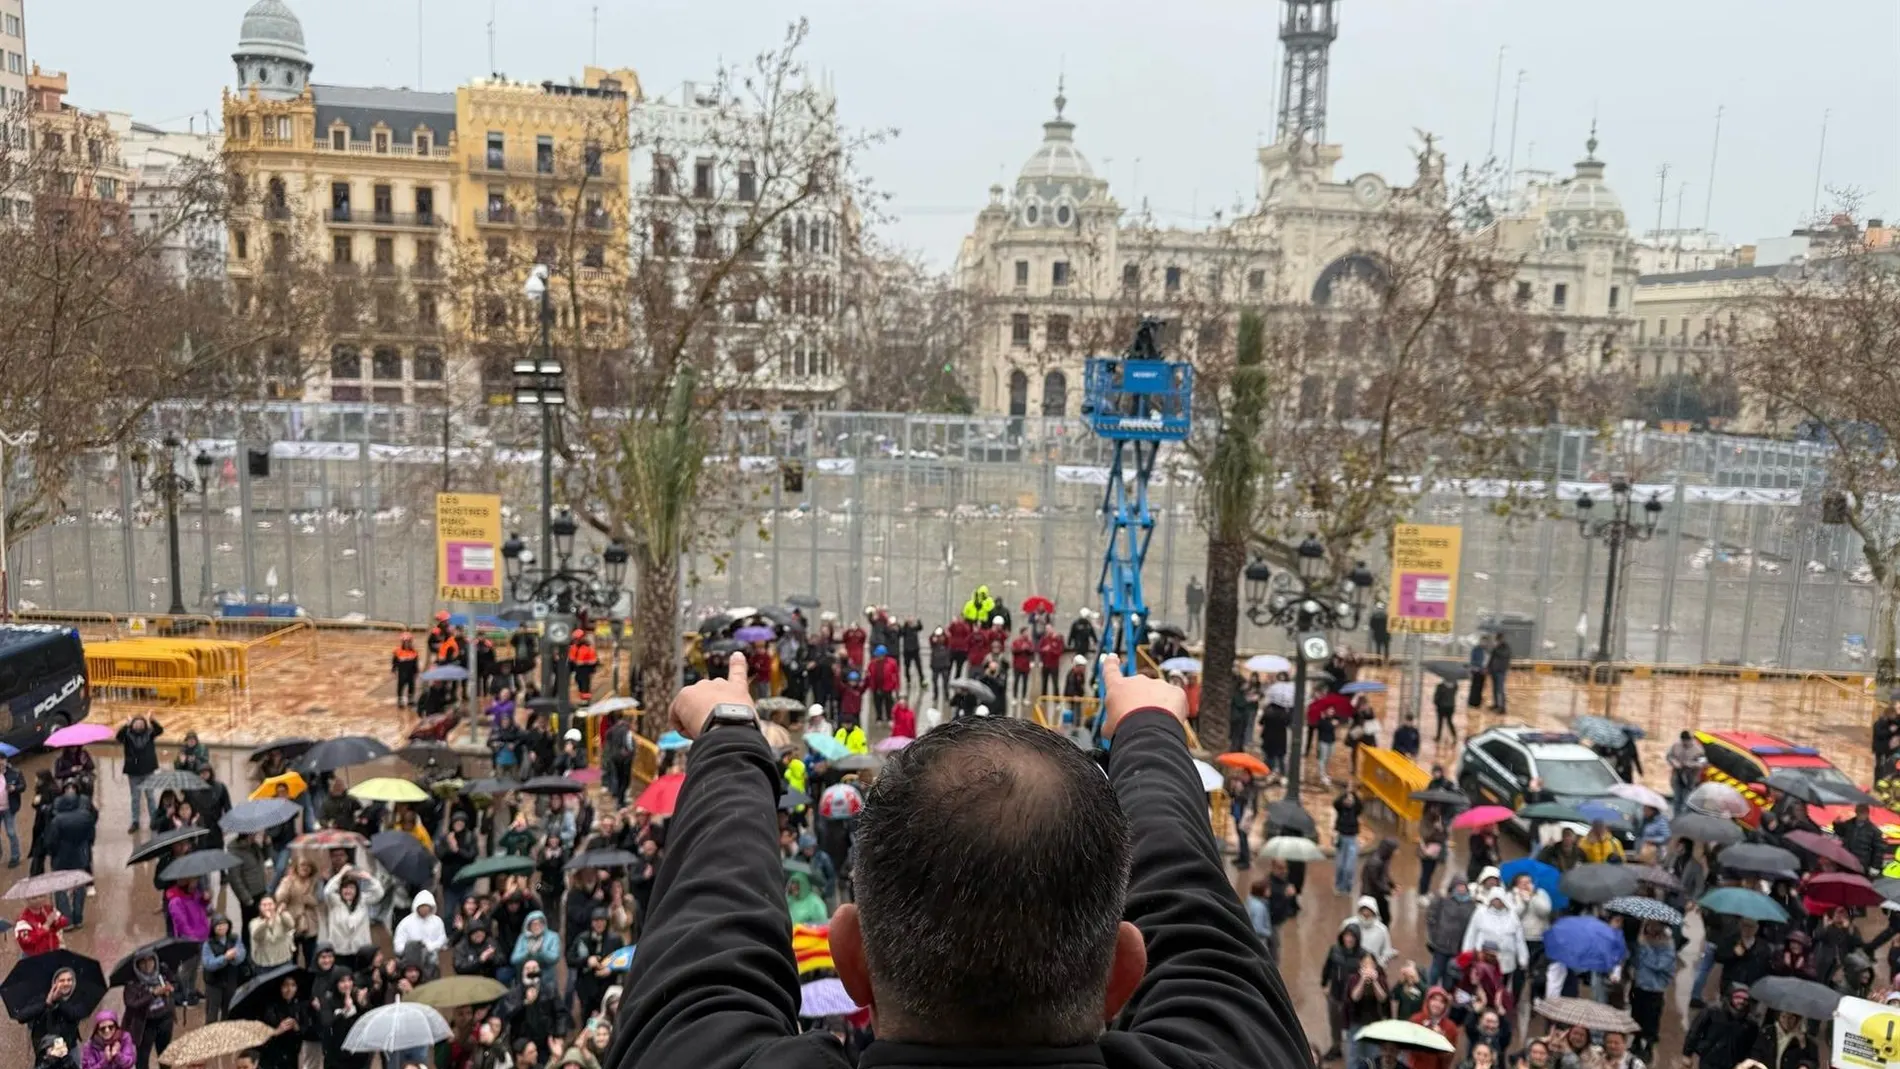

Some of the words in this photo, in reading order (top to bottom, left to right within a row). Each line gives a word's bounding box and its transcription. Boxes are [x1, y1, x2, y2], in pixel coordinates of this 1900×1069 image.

[440, 496, 459, 504] LES
[440, 507, 489, 517] NOSTRES
[1398, 538, 1449, 548] NOSTRES
[441, 586, 501, 602] FALLES
[1390, 617, 1451, 633] FALLES
